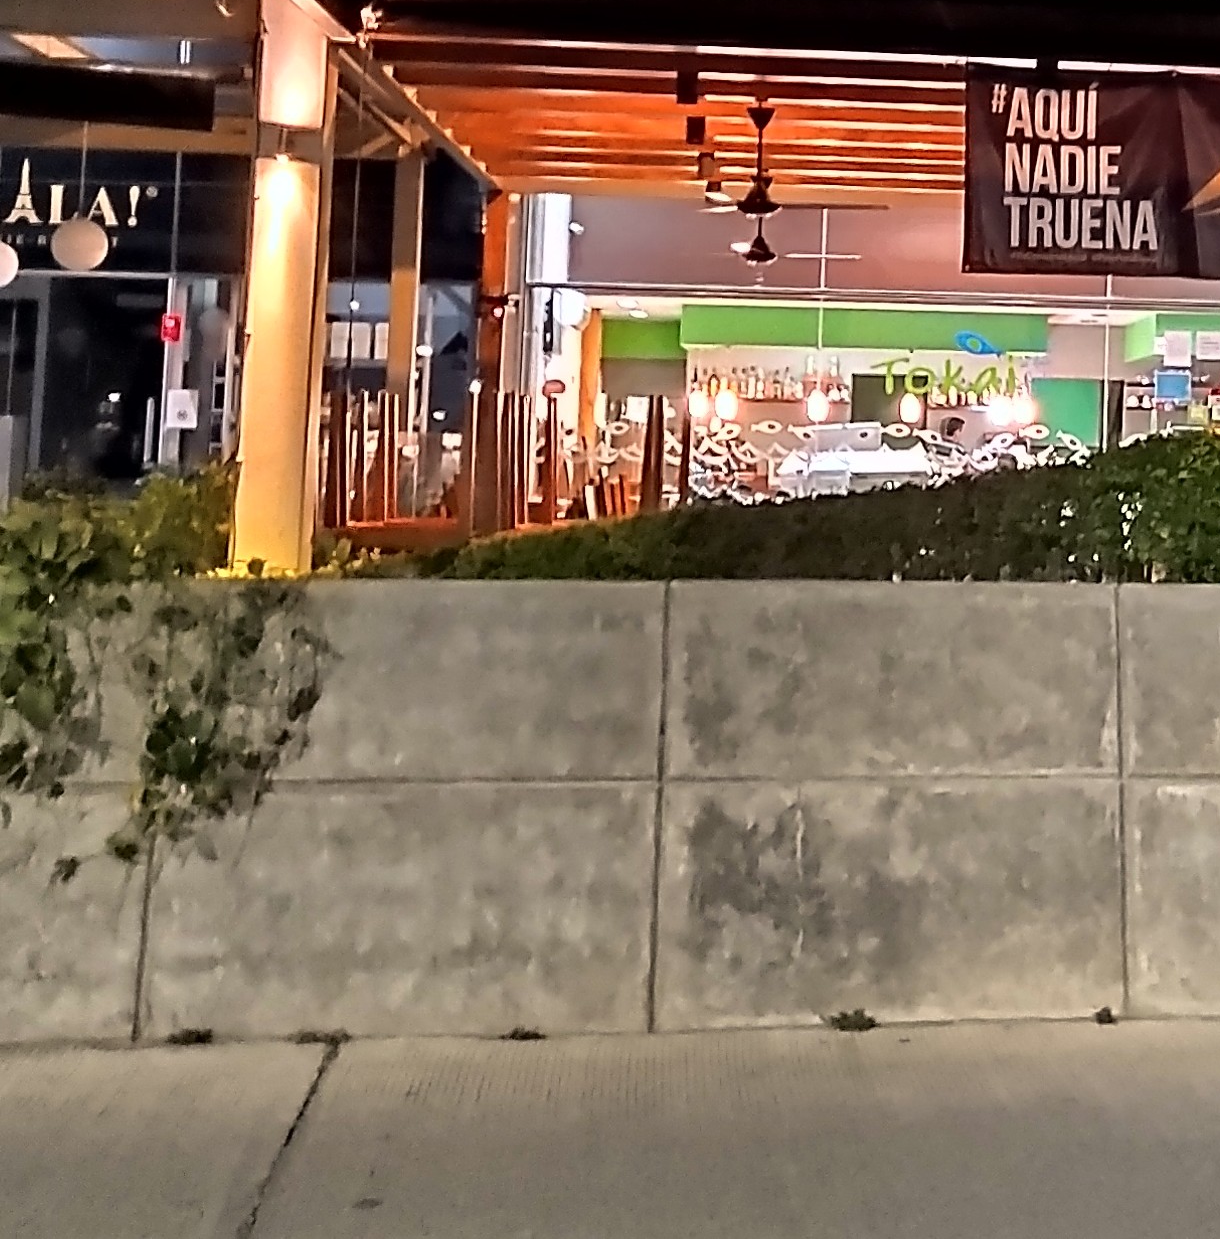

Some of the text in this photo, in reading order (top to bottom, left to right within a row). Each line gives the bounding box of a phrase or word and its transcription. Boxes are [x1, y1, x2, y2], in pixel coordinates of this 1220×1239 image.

[991, 81, 1099, 141] #AQUÍ
[1004, 141, 1122, 195] NADIE
[1003, 196, 1158, 251] TRUENA
[870, 354, 1016, 397] Tokai
